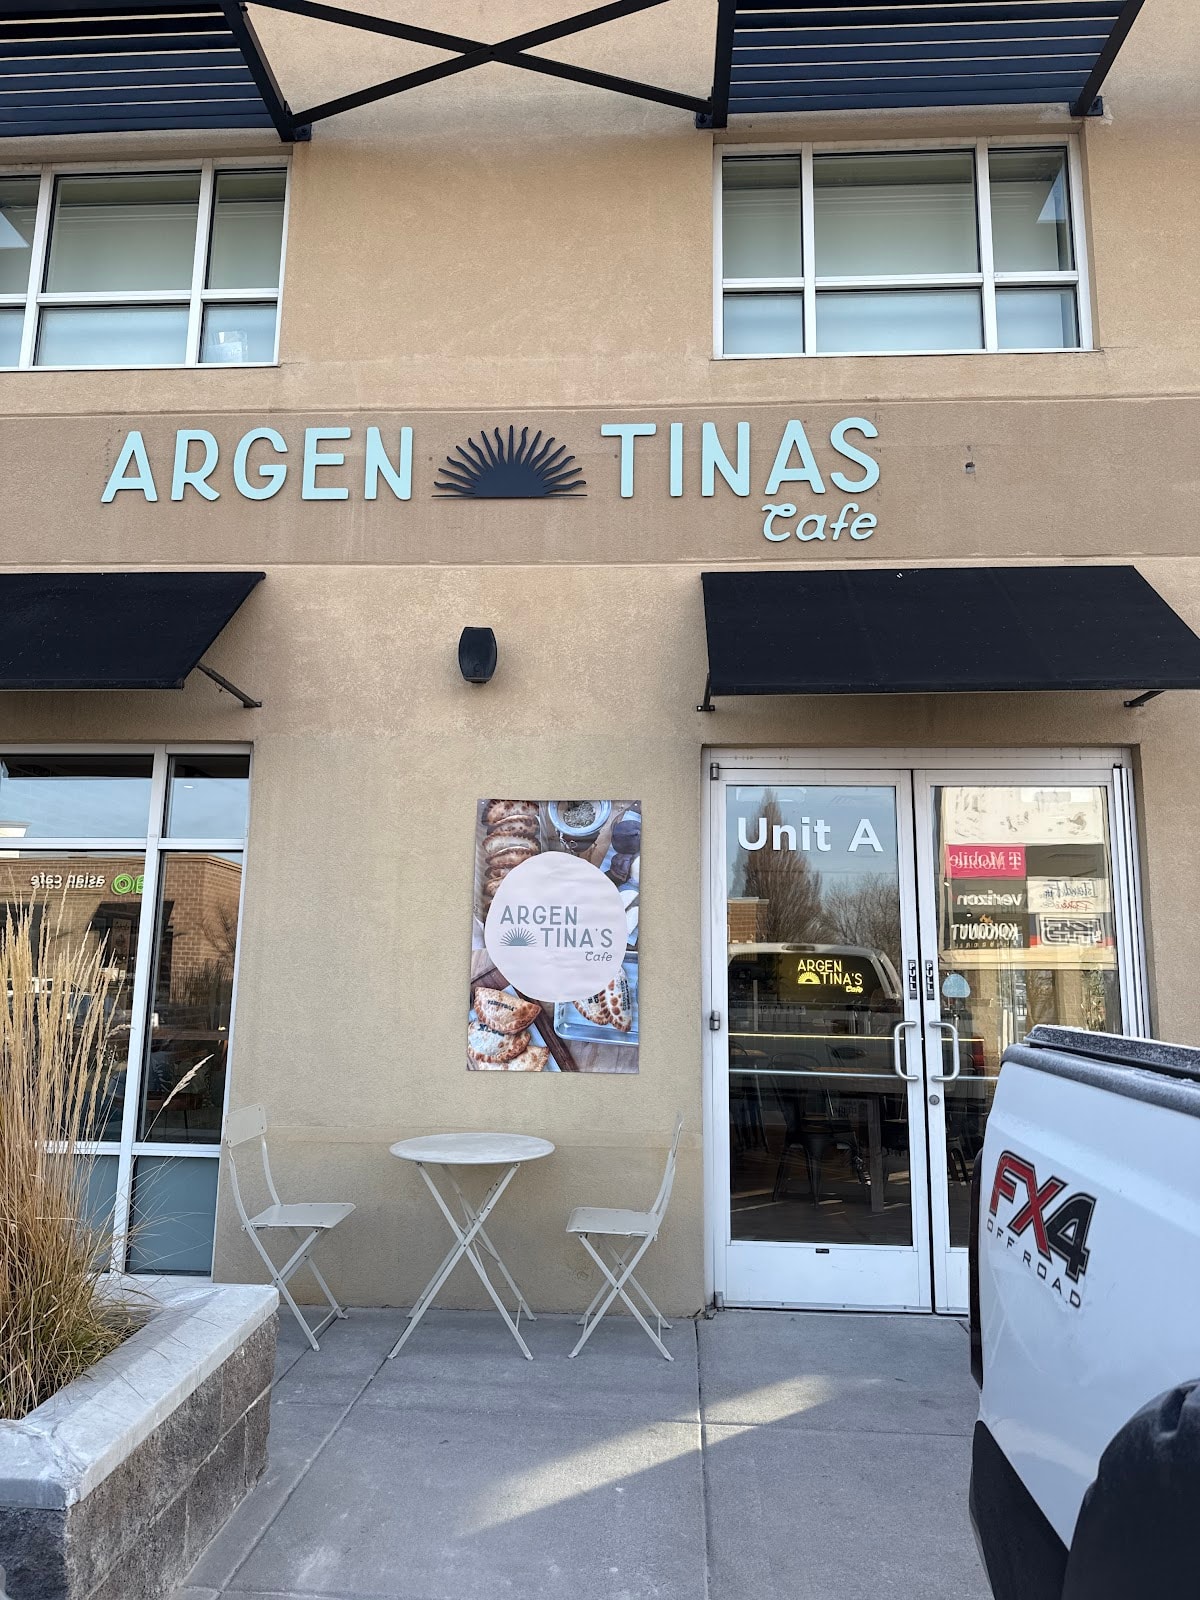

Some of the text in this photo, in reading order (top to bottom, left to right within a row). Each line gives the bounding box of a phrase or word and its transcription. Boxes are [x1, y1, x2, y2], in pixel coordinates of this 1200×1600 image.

[102, 418, 879, 502] ARGEN TINAS
[764, 504, 876, 540] Cafe
[738, 817, 884, 852] Unit A
[500, 905, 578, 926] ARGEN
[540, 928, 613, 948] TINA'S
[584, 951, 613, 962] Cafe
[797, 959, 842, 972] ARGEN
[820, 972, 862, 985] TINA'S
[989, 1150, 1097, 1284] FX4
[987, 1218, 1081, 1309] OFF ROAD
